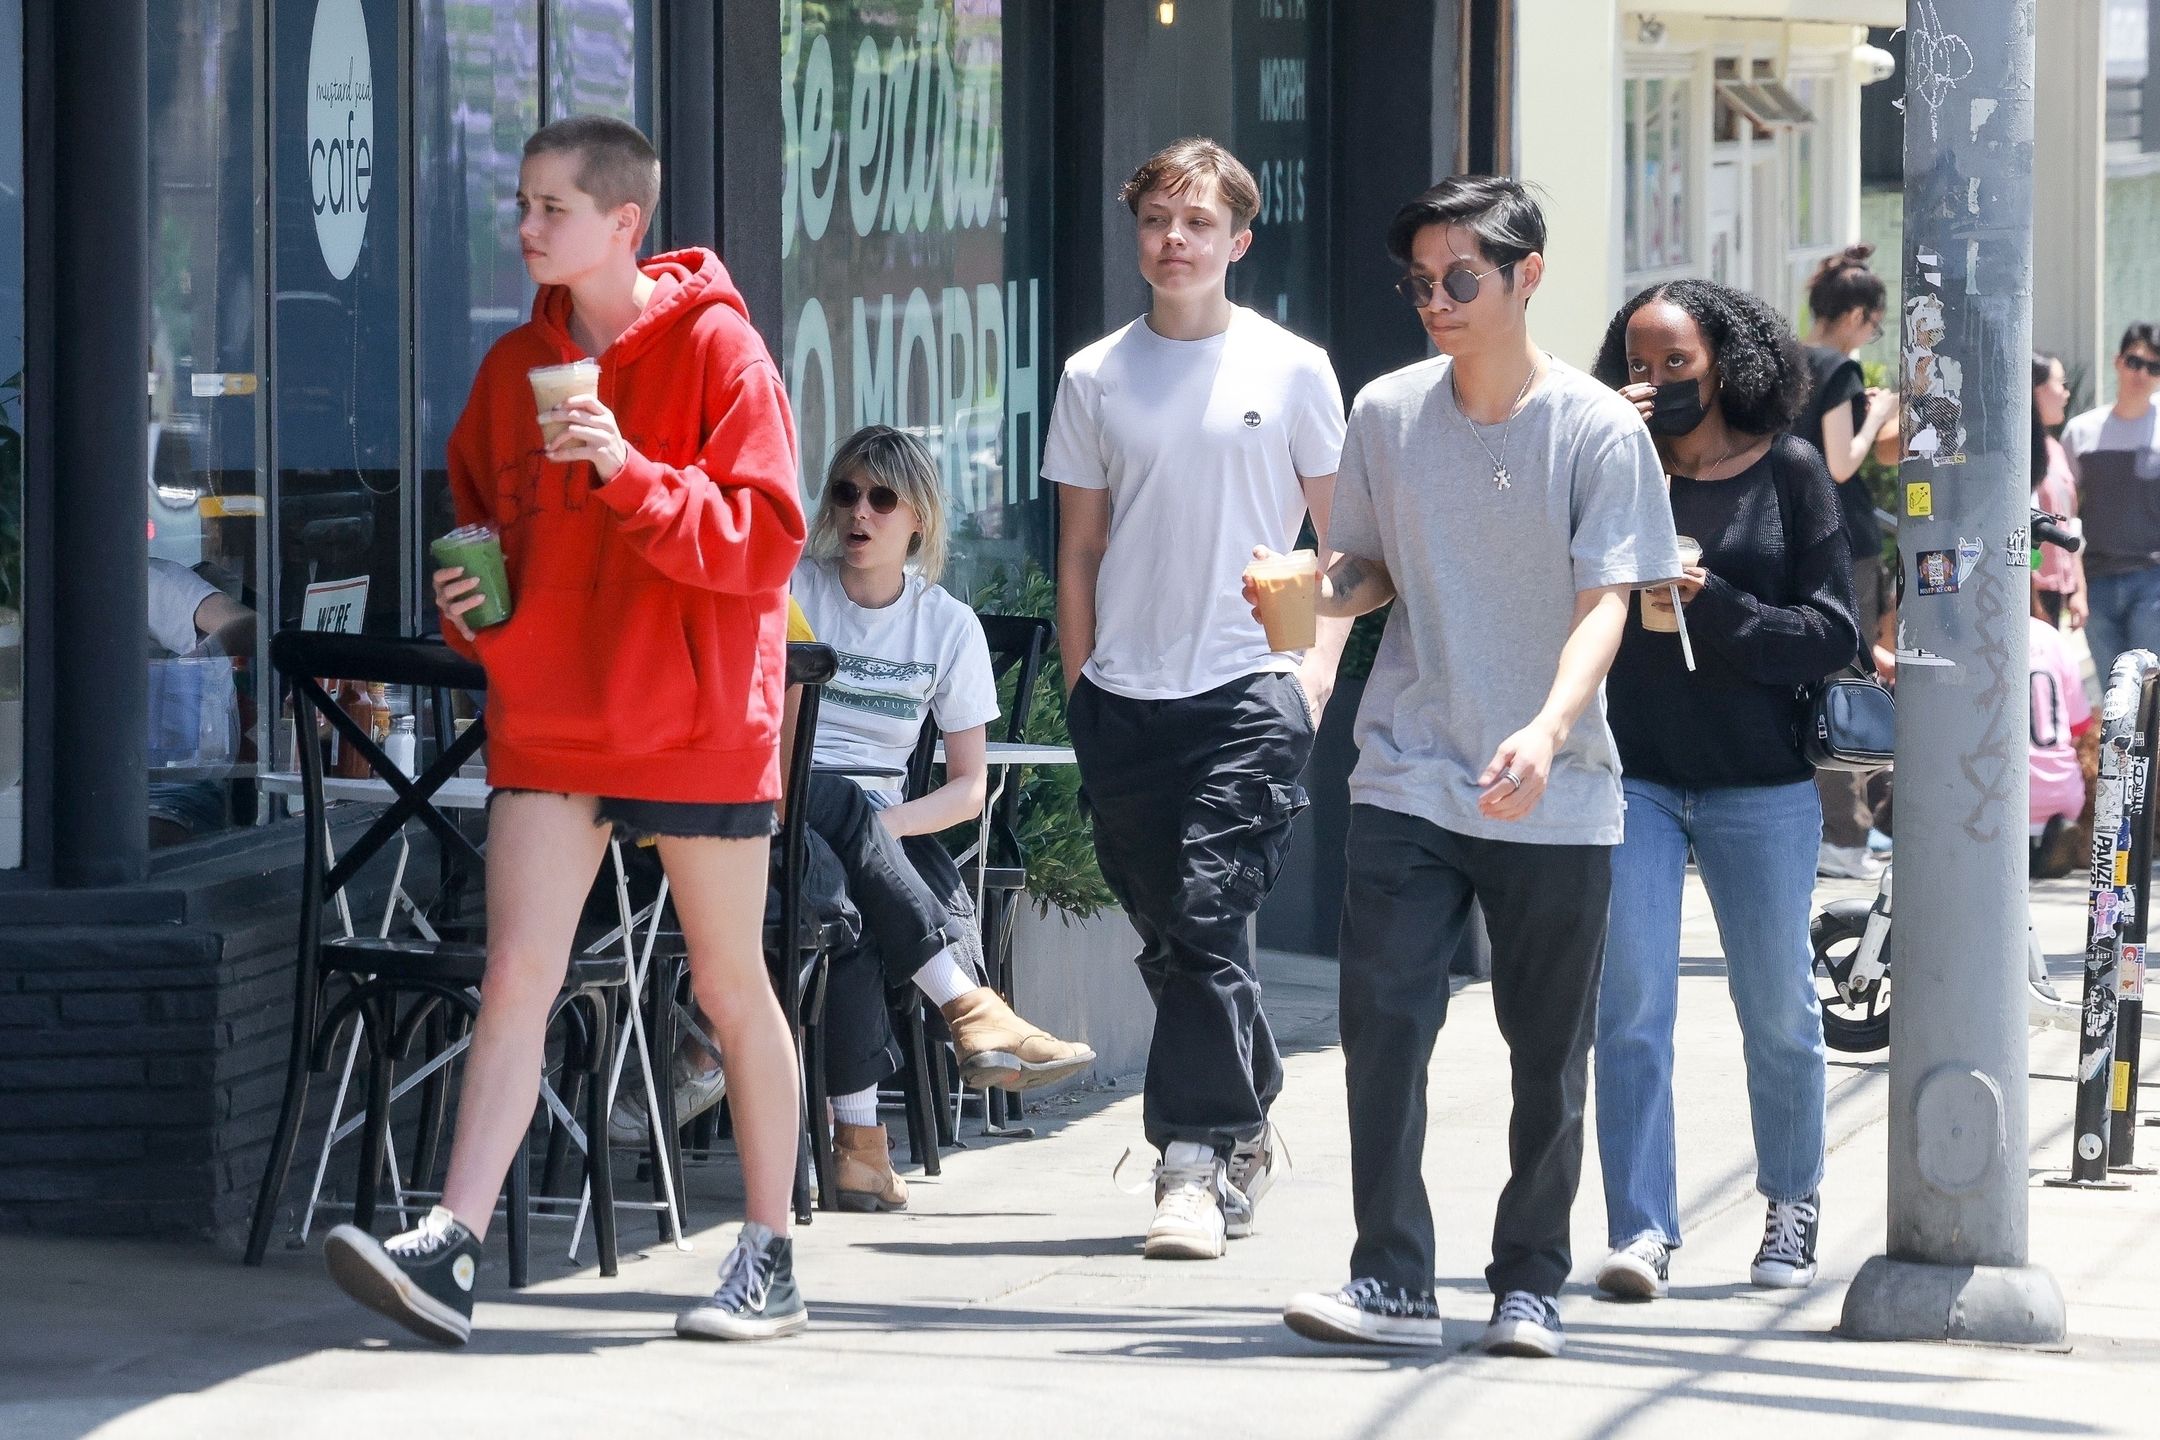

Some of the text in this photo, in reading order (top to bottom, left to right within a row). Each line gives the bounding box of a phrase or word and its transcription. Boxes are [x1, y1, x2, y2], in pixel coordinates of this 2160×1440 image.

[316, 56, 354, 108] mustard
[1260, 58, 1306, 121] MORPH
[310, 110, 372, 215] cafe
[1260, 159, 1305, 225] OSIS
[853, 278, 1039, 518] MORPH
